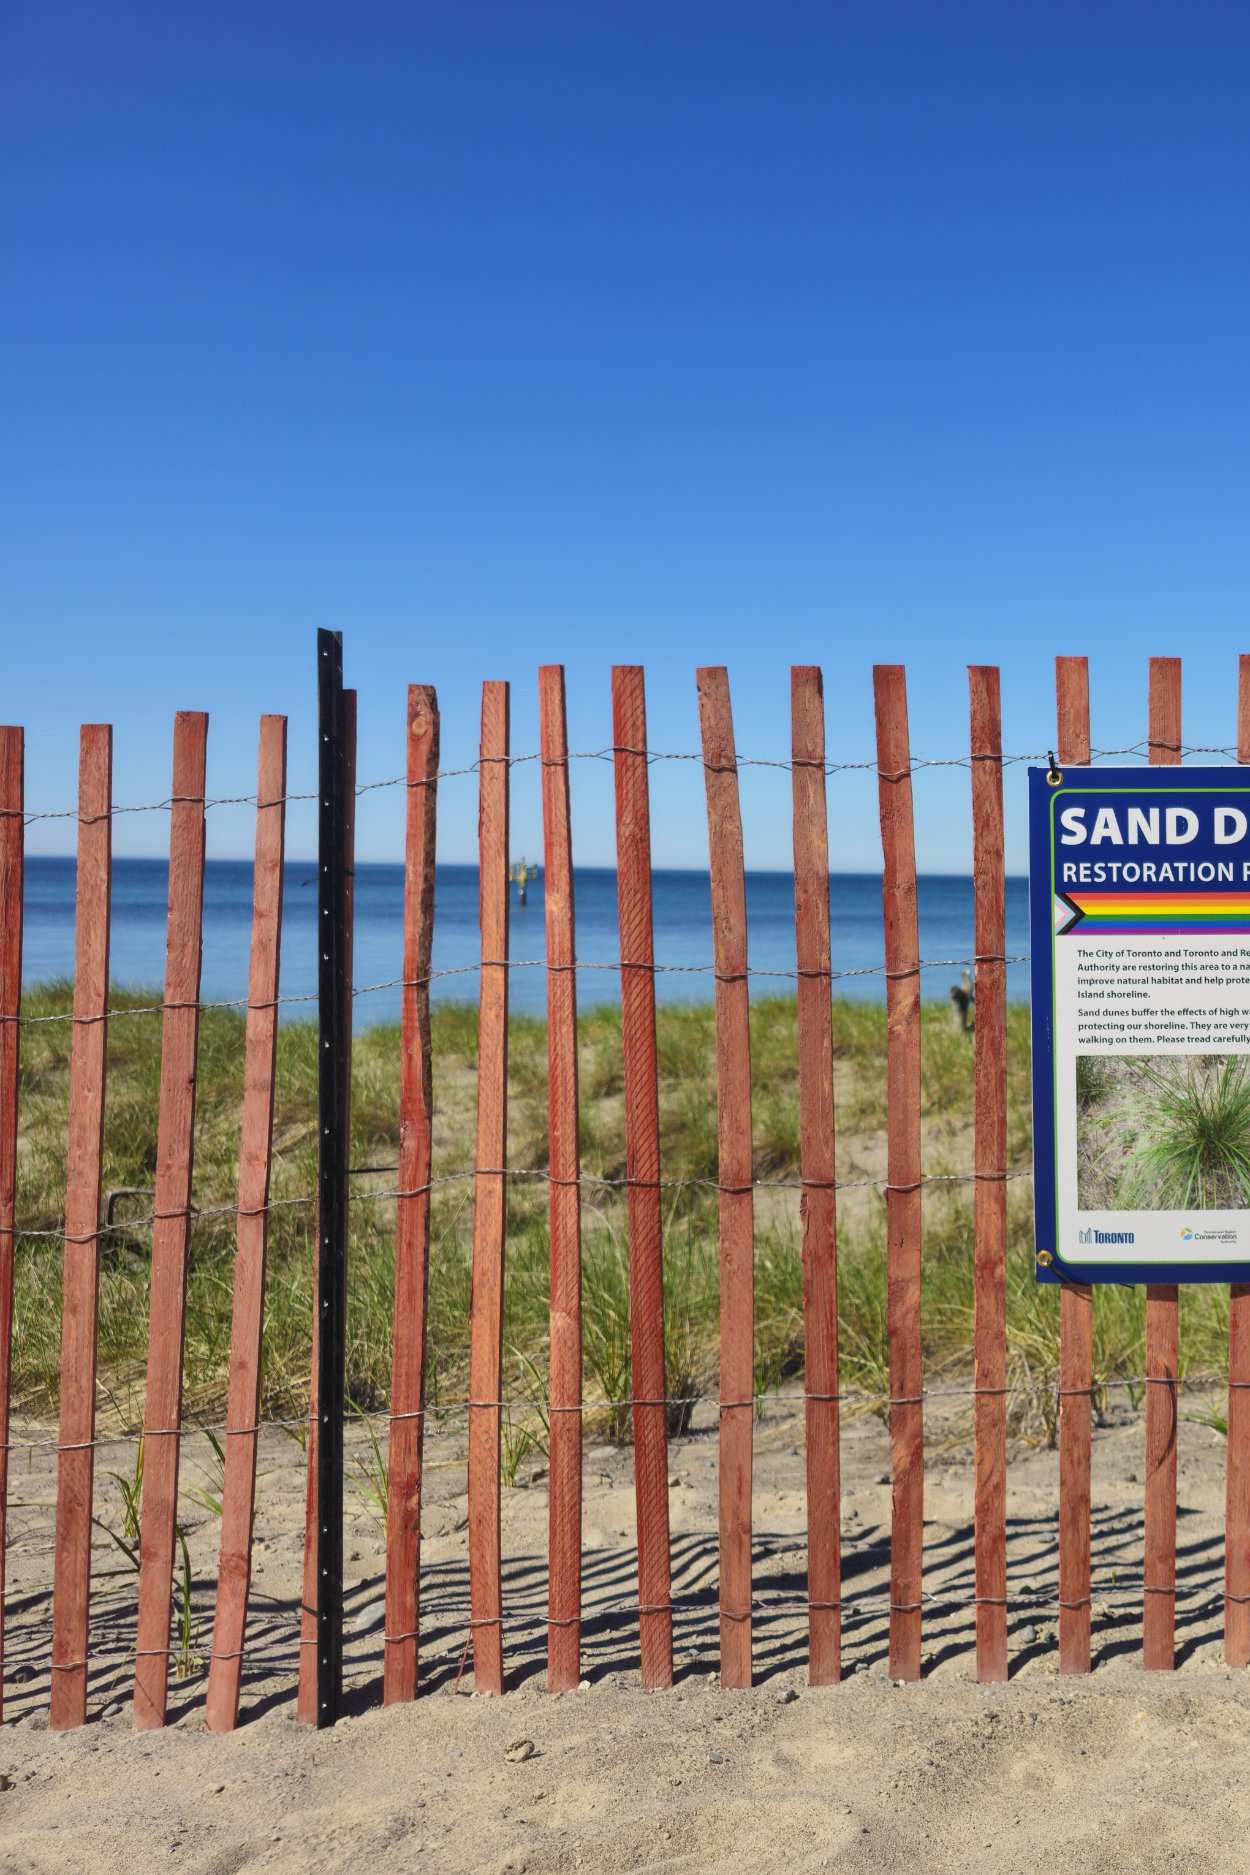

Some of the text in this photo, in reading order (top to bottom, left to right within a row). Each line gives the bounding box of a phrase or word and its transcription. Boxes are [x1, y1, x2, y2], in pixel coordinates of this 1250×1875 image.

[1060, 807, 1200, 846] SAND
[1063, 862, 1235, 883] RESTORATION
[1077, 950, 1094, 958] The
[1096, 949, 1113, 960] City
[1115, 949, 1125, 958] of
[1126, 949, 1162, 958] Toronto
[1164, 949, 1181, 957] and
[1183, 949, 1219, 957] Toronto
[1221, 948, 1238, 957] and
[1077, 963, 1120, 973] Authority
[1139, 963, 1179, 973] restoring
[1181, 962, 1198, 971] this
[1078, 977, 1115, 987] improve
[1117, 976, 1149, 985] natural
[1151, 976, 1183, 985] habitat
[1185, 976, 1202, 984] and
[1204, 976, 1224, 986] help
[1078, 990, 1150, 999] Island shoreline.
[1078, 1008, 1100, 1016] Sand
[1102, 1008, 1129, 1016] dunes
[1131, 1008, 1159, 1016] buffer
[1160, 1008, 1175, 1016] the
[1177, 1008, 1206, 1016] effects
[1208, 1008, 1218, 1016] of
[1220, 1008, 1239, 1018] high
[1078, 1022, 1125, 1032] protecting
[1144, 1022, 1188, 1030] shoreline.
[1190, 1021, 1212, 1031] They
[1078, 1035, 1113, 1046] walking
[1129, 1035, 1155, 1044] them.
[1157, 1035, 1185, 1043] Please
[1187, 1035, 1211, 1043] tread
[1093, 1230, 1134, 1244] TORONTO
